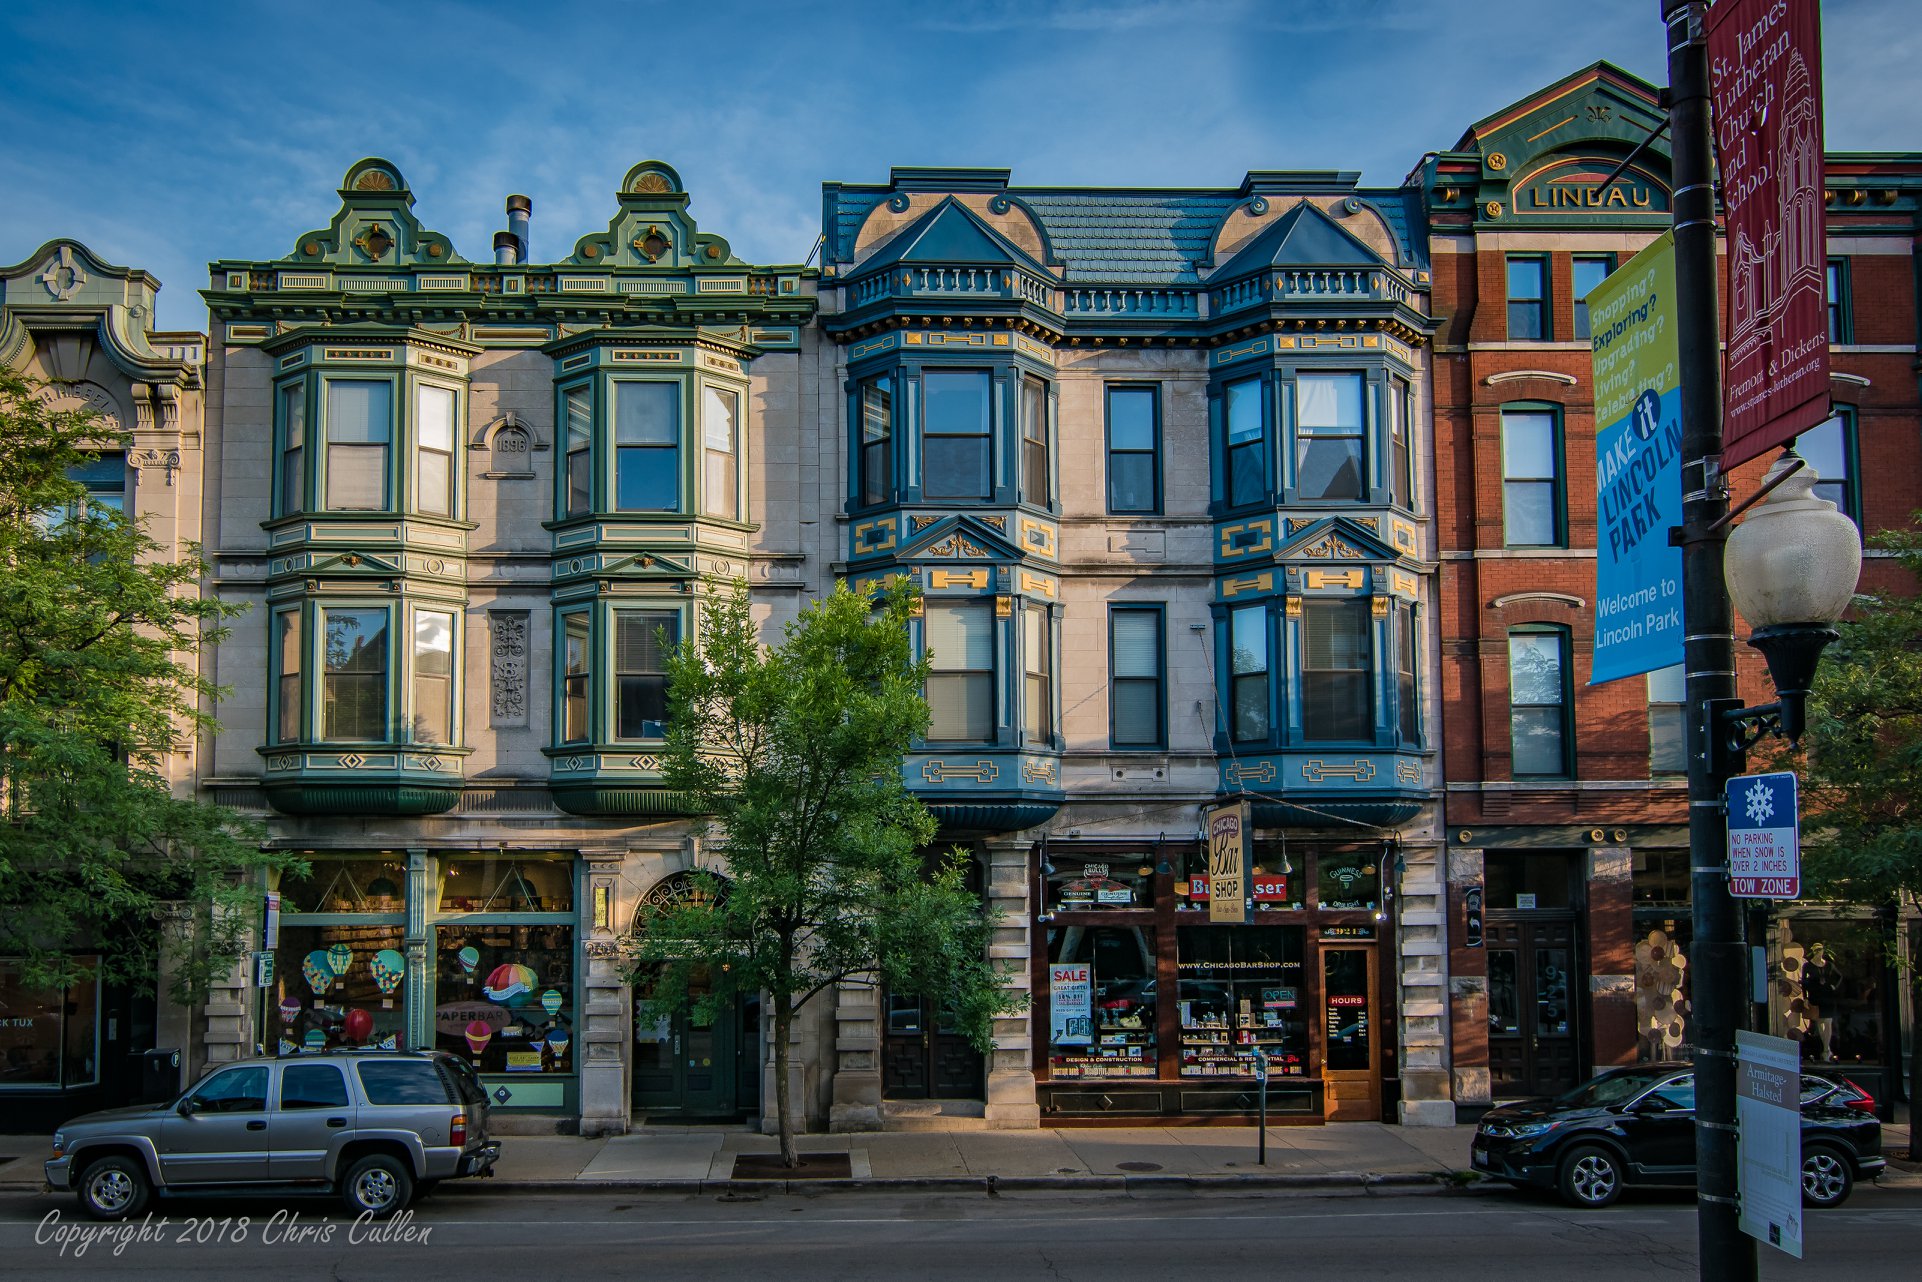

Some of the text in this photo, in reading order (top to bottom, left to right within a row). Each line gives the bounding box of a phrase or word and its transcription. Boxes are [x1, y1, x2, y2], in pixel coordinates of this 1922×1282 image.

[1712, 0, 1787, 88] St. James
[1715, 30, 1790, 121] Lutheran
[1724, 137, 1747, 187] and
[1534, 187, 1649, 207] LINDAU
[1726, 150, 1773, 220] School
[1592, 268, 1656, 329] Shopping?
[1593, 293, 1657, 353] Exploring?
[1594, 314, 1665, 376] Upgrading?
[1768, 359, 1778, 376] &
[1780, 331, 1825, 369] Dickens
[1595, 359, 1636, 400] Living?
[497, 438, 526, 452] 1896
[1597, 395, 1658, 493] MAKE it
[1603, 418, 1683, 527] LINCOLN
[1608, 485, 1662, 565] PARK
[1597, 578, 1676, 618] Welcome to
[1596, 607, 1680, 649] Lincoln Park
[1213, 817, 1238, 833] CHICAGO
[1732, 833, 1774, 845] NO PARKING
[1211, 832, 1239, 876] Bar
[1732, 846, 1785, 859] WHEN SNOW IS
[1732, 860, 1788, 872] OVER 2 INCHES
[1215, 880, 1238, 899] SHOP
[1733, 878, 1792, 894] TOW ZONE
[1054, 970, 1087, 982] SALE
[1263, 990, 1295, 1000] OPEN
[12, 1018, 33, 1027] TUX
[1746, 1063, 1787, 1088] Armitage-
[1751, 1081, 1782, 1103] Halsted
